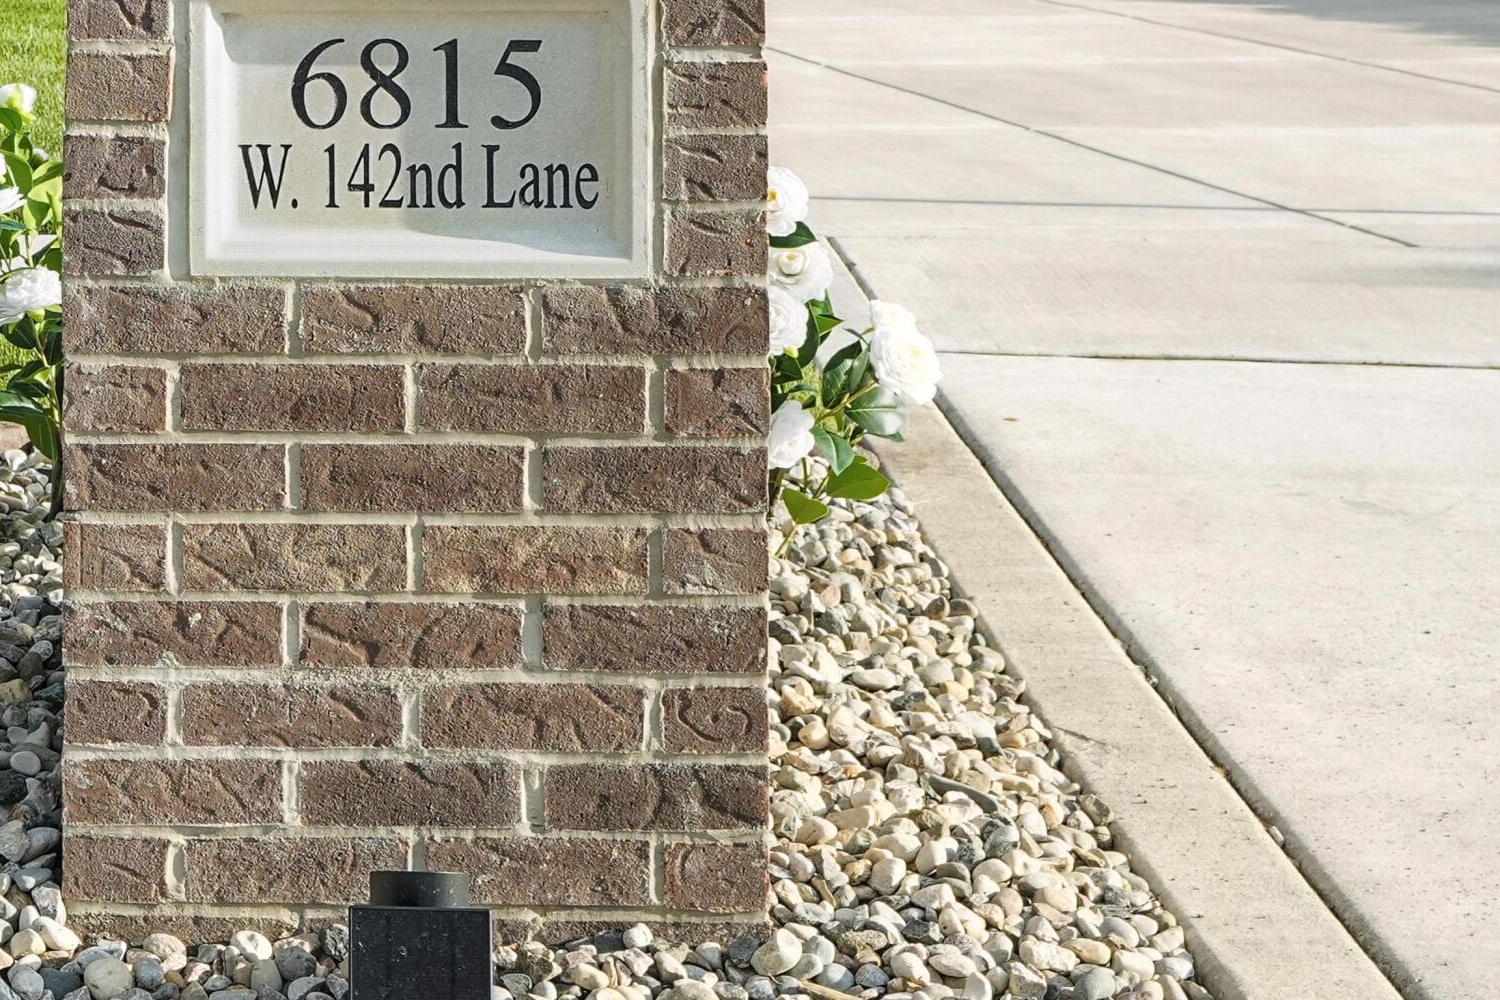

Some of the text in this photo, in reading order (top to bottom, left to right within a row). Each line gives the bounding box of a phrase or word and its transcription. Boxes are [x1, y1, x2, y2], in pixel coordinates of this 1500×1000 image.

[291, 38, 542, 130] 6815
[239, 142, 599, 210] W. 142nd Lane
